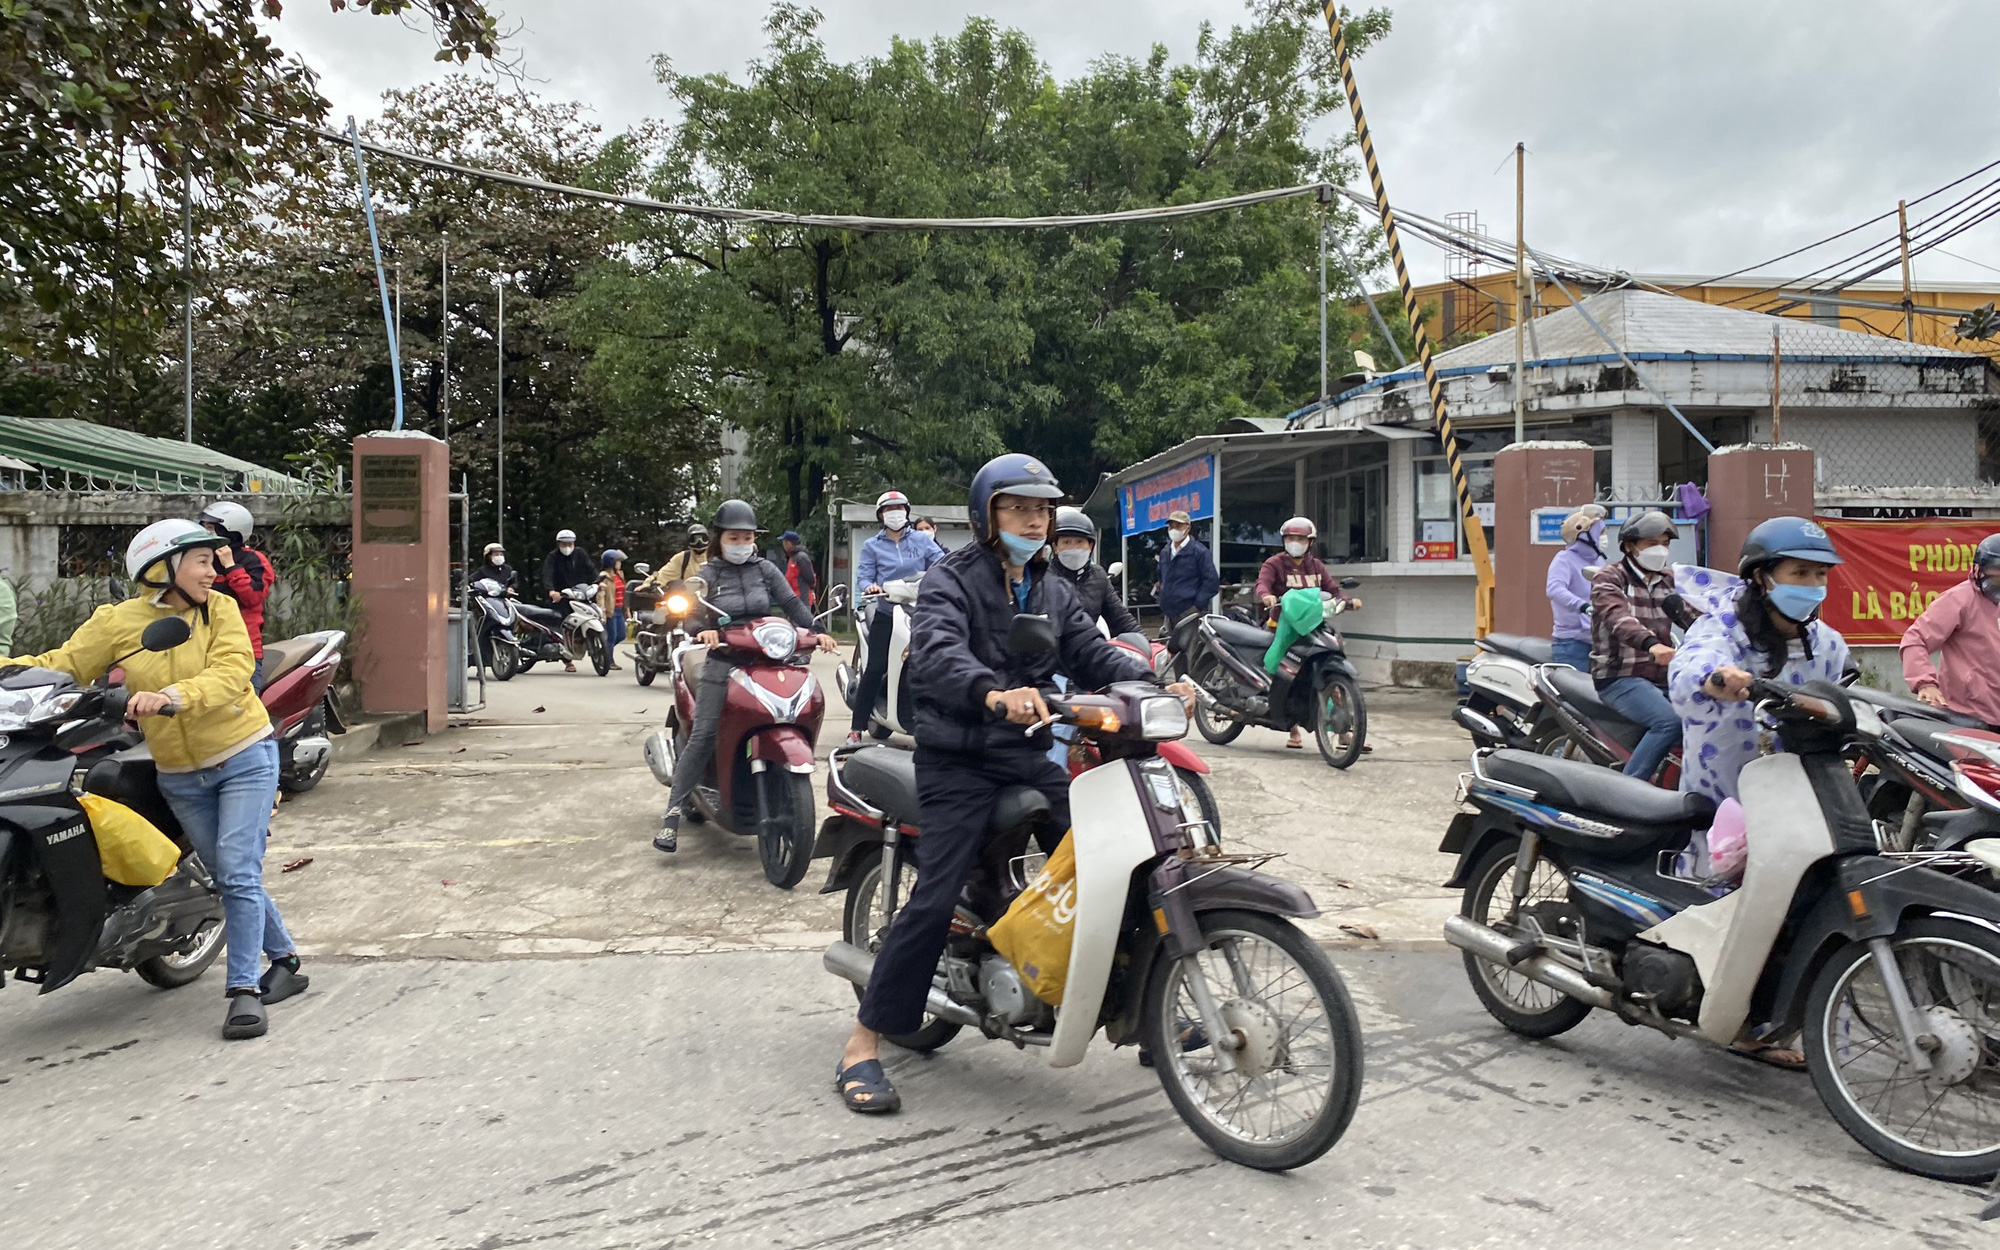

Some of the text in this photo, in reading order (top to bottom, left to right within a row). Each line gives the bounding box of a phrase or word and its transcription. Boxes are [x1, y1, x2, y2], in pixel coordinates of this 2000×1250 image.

[1909, 538, 1978, 572] PHÒN
[1852, 586, 1885, 620] LÀ
[46, 823, 86, 846] YAMAHA
